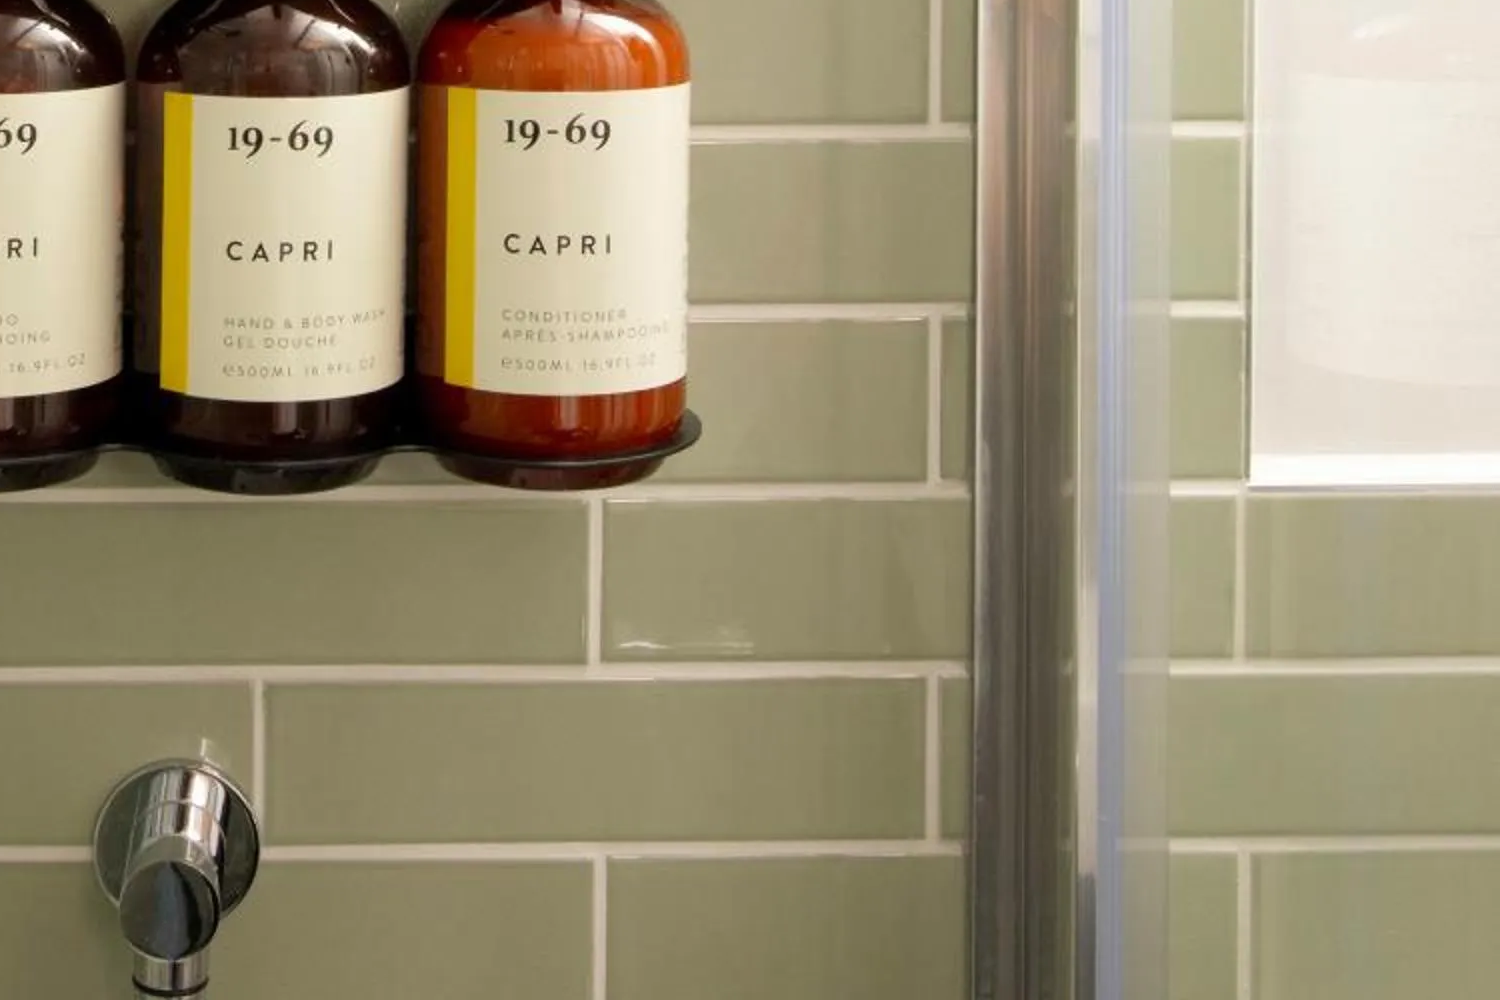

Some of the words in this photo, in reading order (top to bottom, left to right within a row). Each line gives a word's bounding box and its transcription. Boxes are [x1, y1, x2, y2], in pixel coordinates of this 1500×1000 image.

[227, 119, 334, 159] 19-69
[504, 112, 612, 151] 19-69
[226, 239, 334, 262] CAPRI
[503, 233, 612, 256] CAPRI
[223, 317, 275, 331] HAND
[284, 317, 294, 330] &
[301, 314, 346, 330] BODY
[223, 335, 256, 350] GEL
[264, 333, 339, 350] DOUCHE
